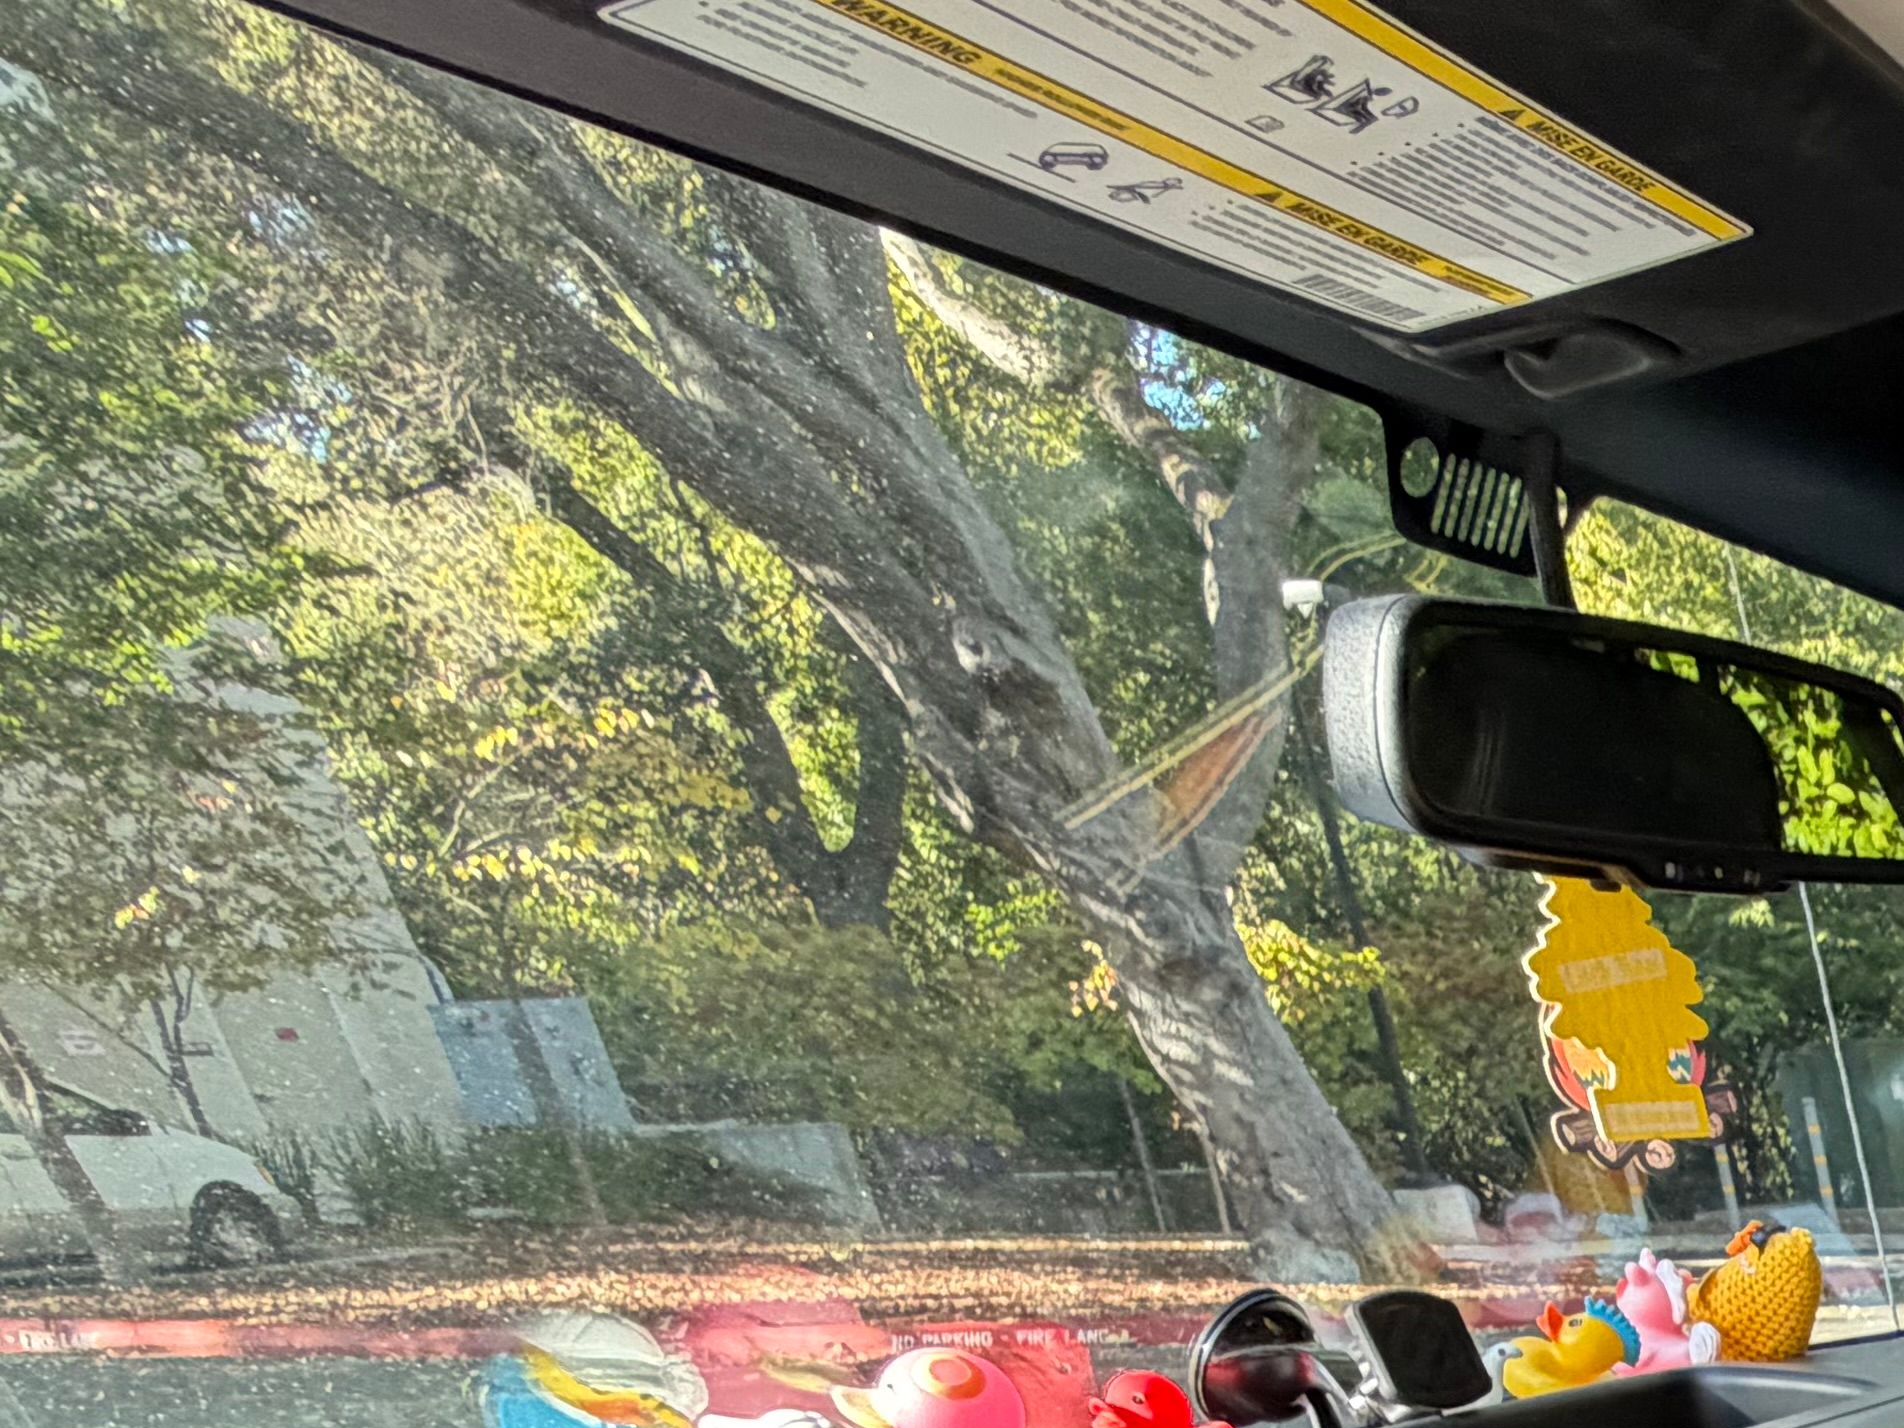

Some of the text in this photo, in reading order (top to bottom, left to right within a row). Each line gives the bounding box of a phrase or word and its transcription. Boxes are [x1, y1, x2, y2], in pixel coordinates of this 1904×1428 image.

[1526, 120, 1656, 192] MISE EN GARDE
[1286, 201, 1429, 266] MISE EN GARDE
[921, 1329, 993, 1348] PARKING
[1015, 1328, 1055, 1345] FIRE
